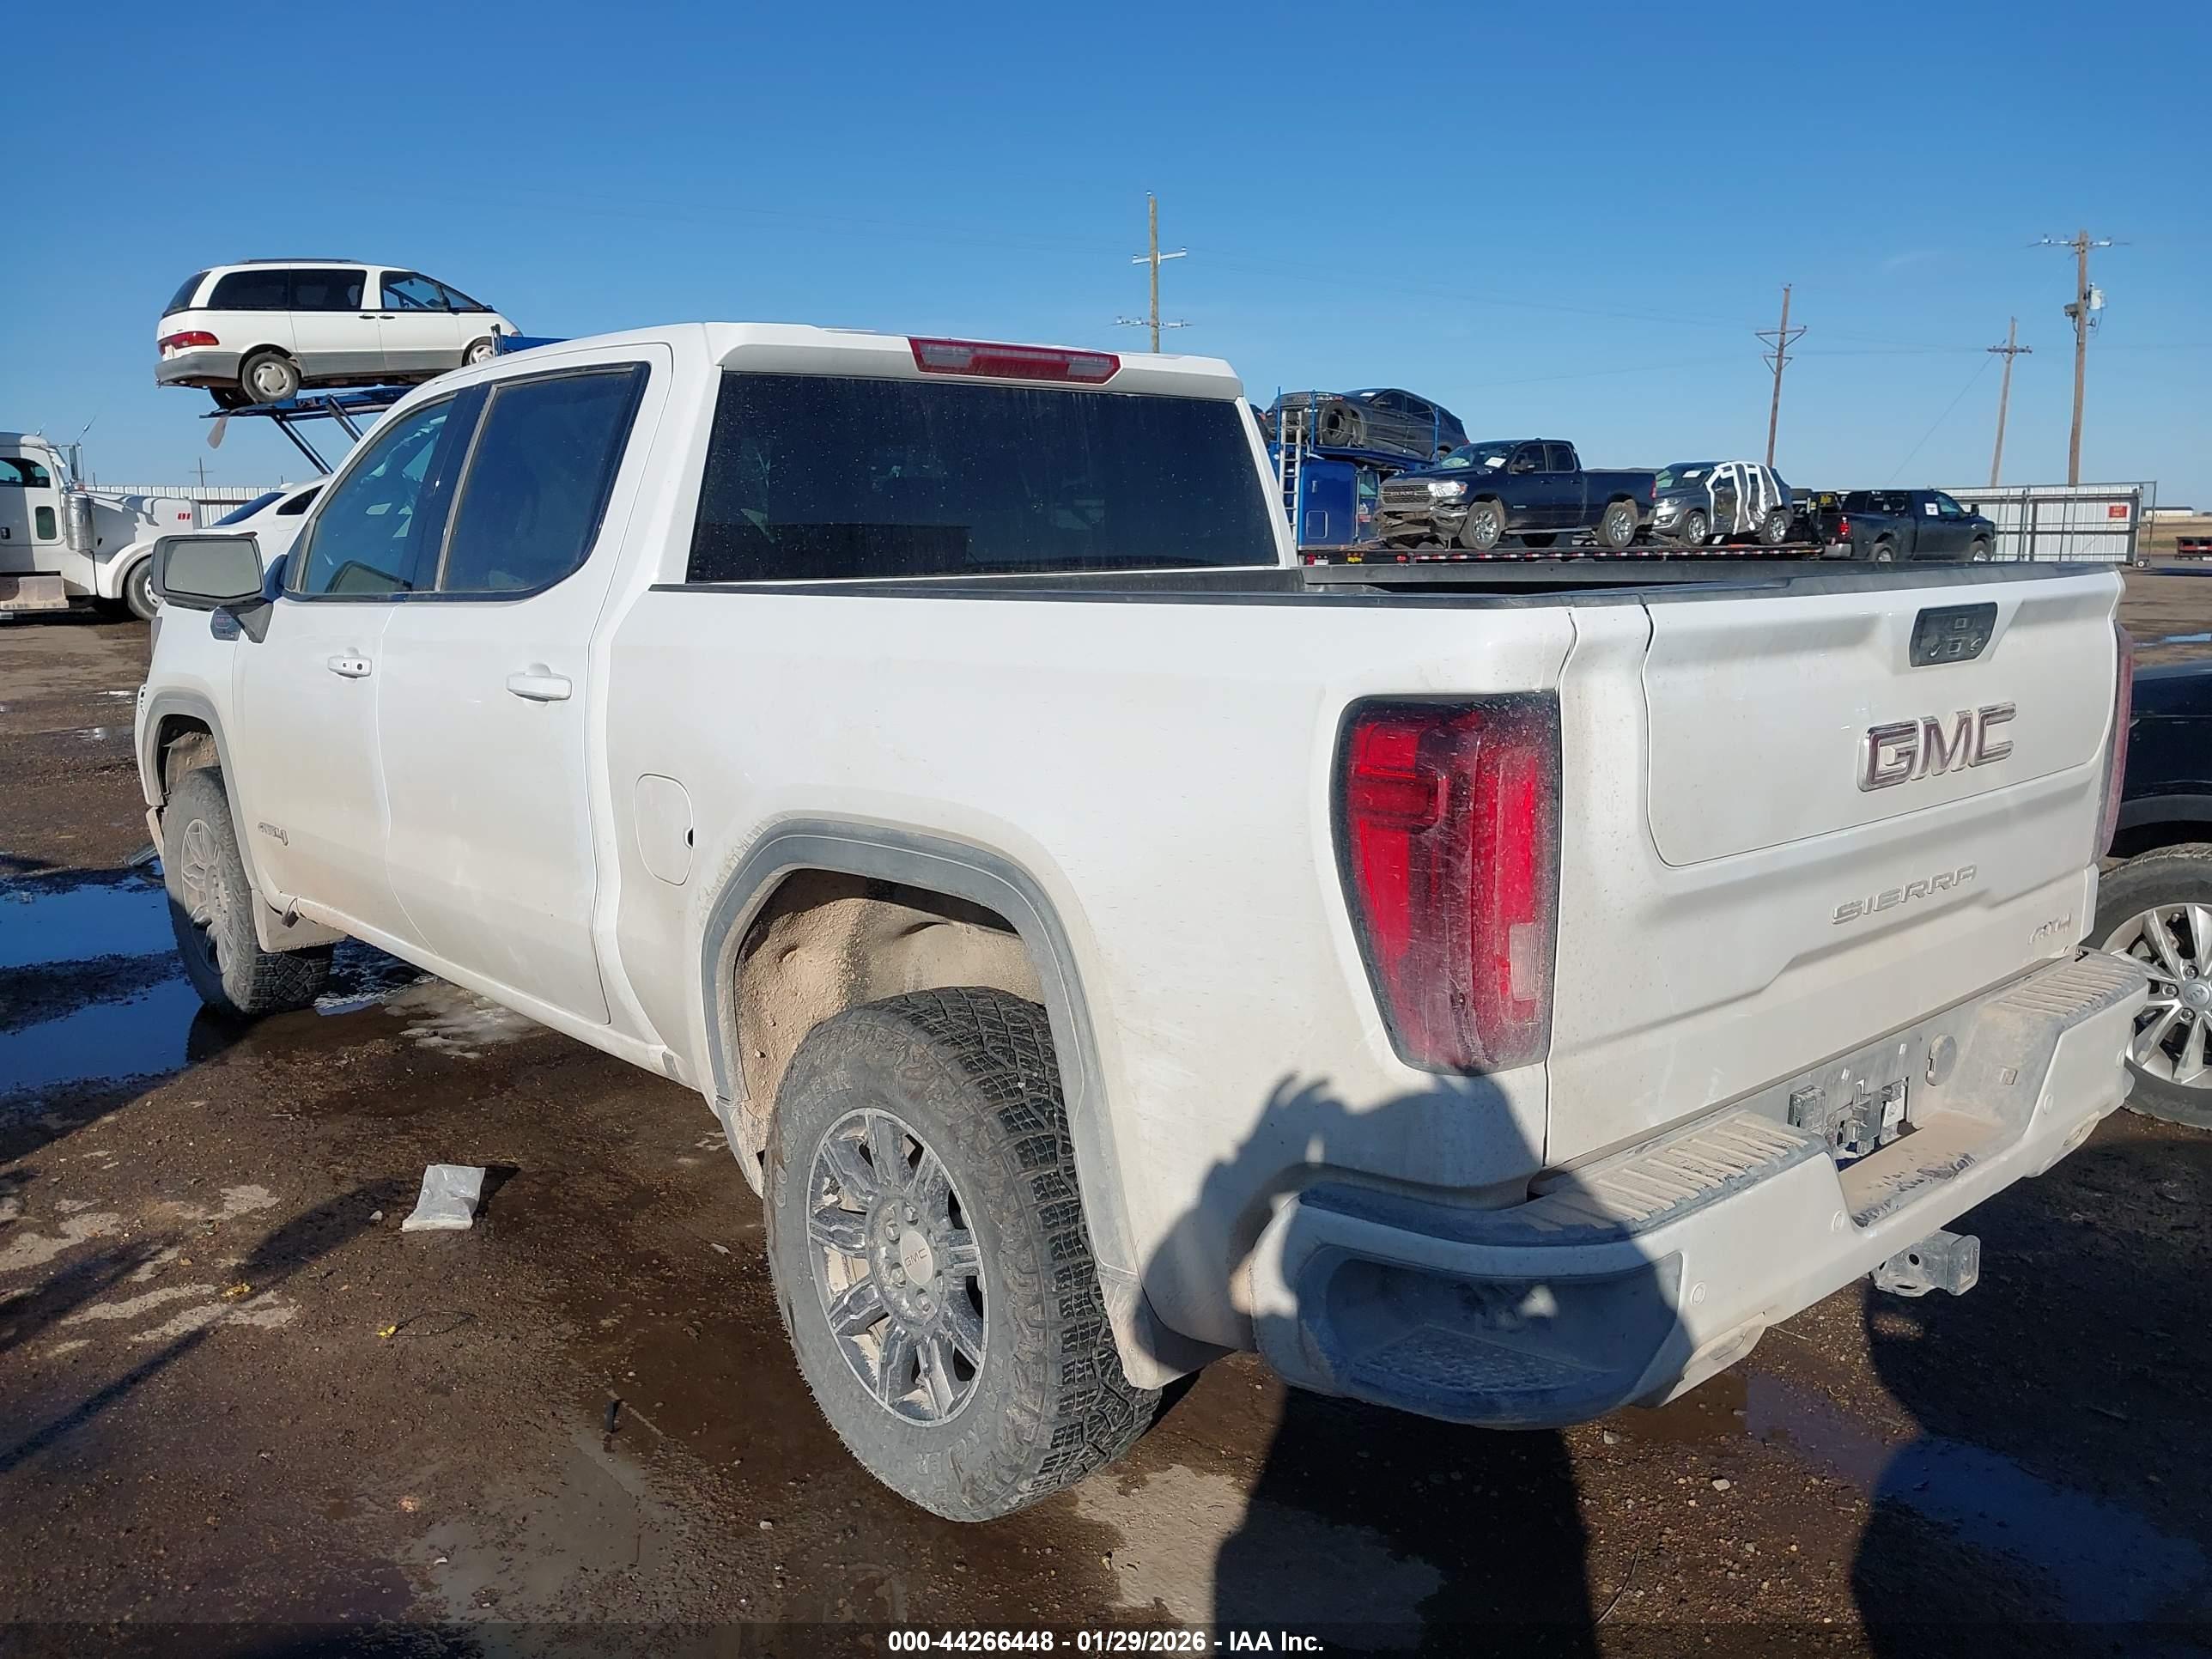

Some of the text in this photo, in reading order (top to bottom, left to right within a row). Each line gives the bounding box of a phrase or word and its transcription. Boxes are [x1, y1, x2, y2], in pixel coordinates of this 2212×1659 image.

[1857, 702, 2016, 792] GMC
[1832, 864, 1977, 925] SIERRA
[904, 1248, 928, 1267] GMC
